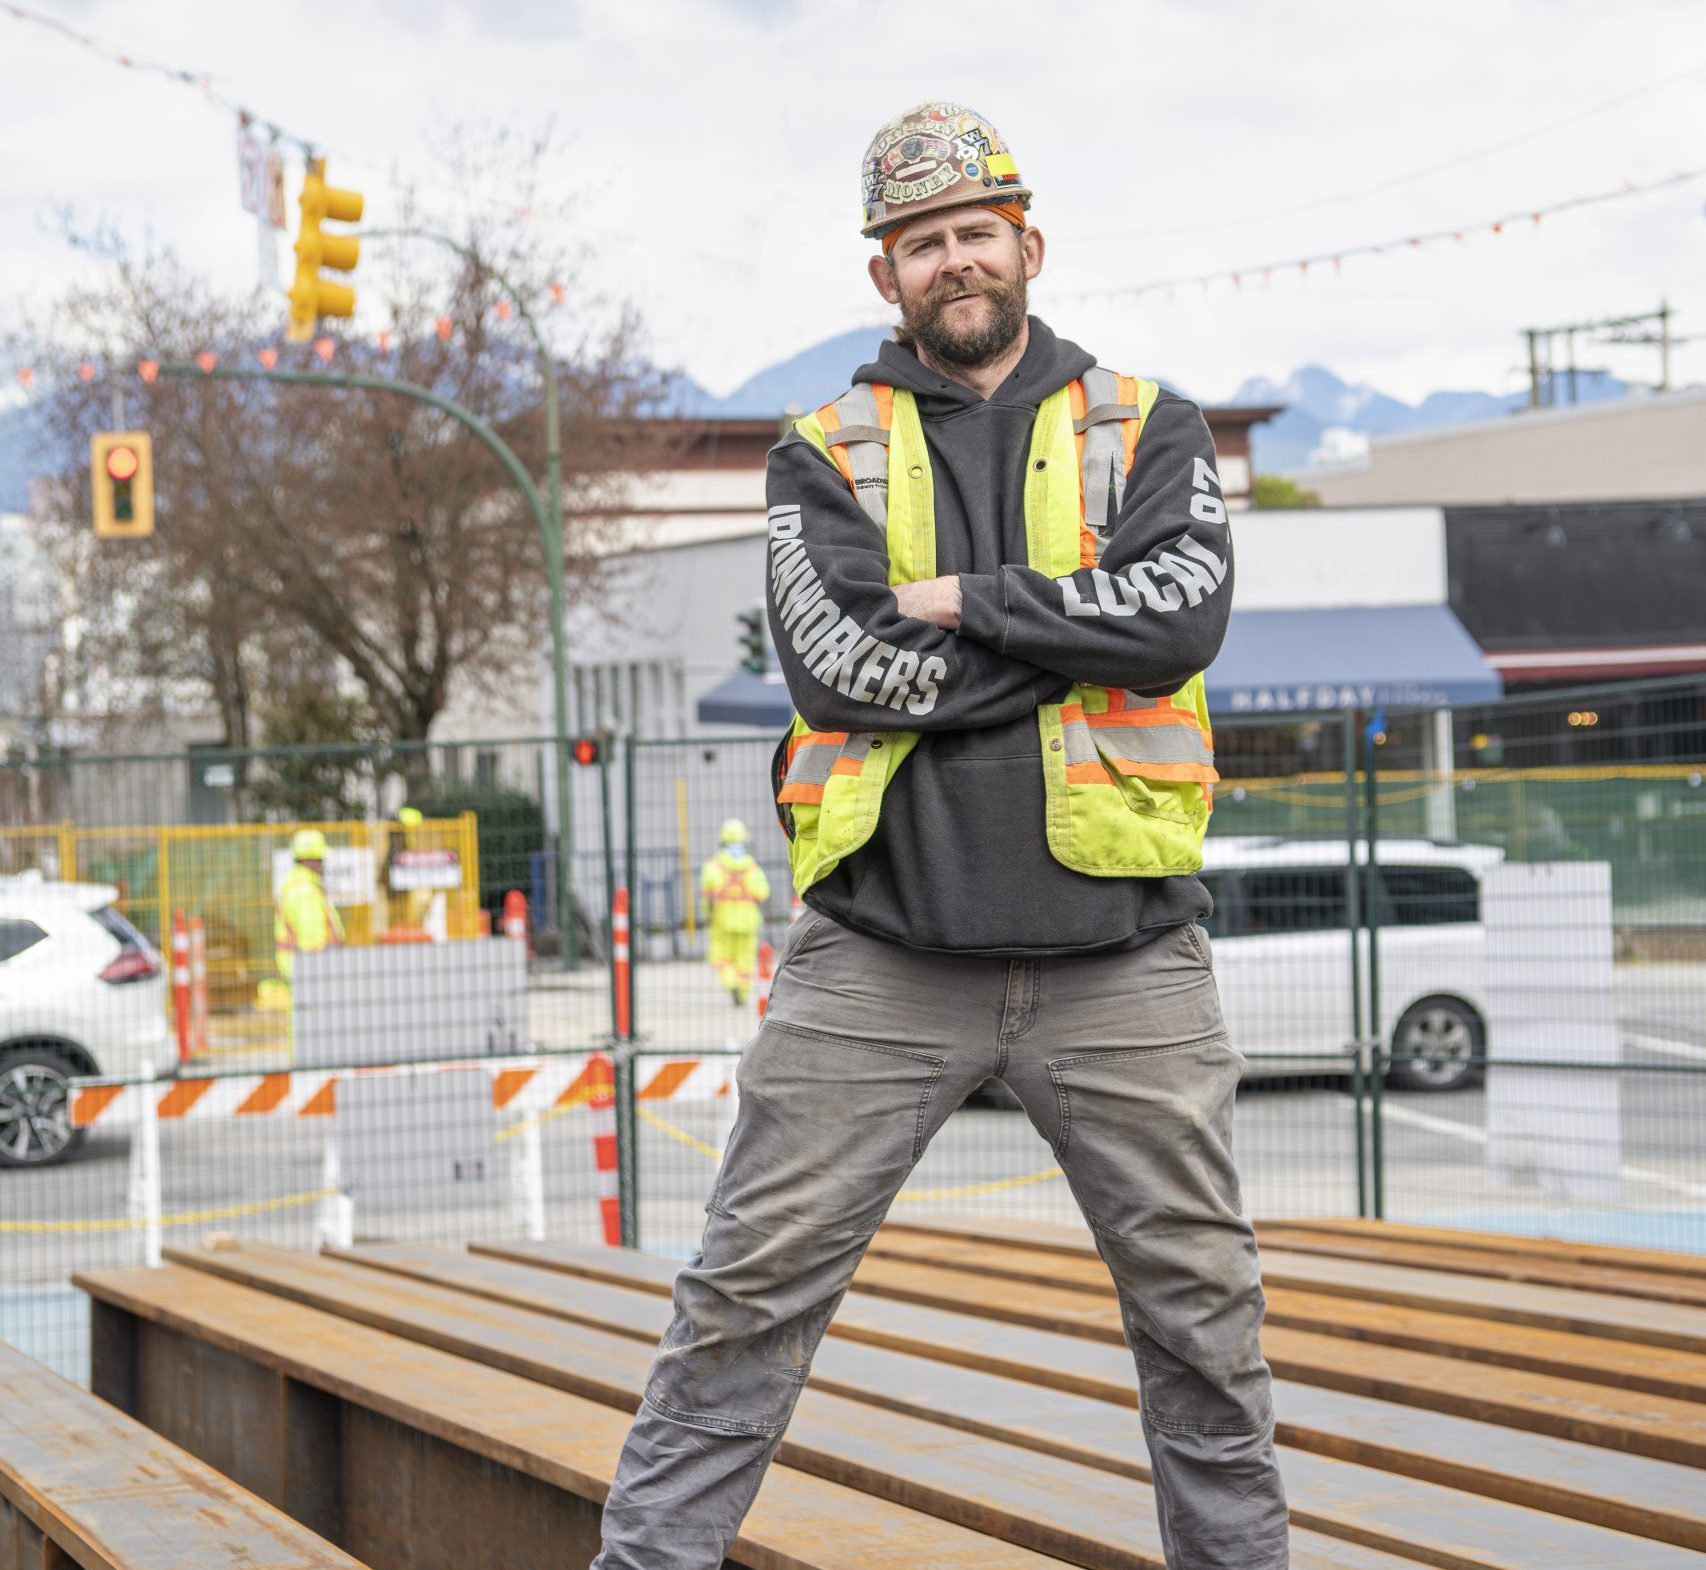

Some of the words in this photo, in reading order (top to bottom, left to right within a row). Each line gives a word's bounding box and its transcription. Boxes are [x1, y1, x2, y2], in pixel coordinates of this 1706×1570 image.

[884, 163, 960, 202] MONEY
[768, 504, 948, 716] IRONWORKERS
[1056, 534, 1227, 617] LOCAL
